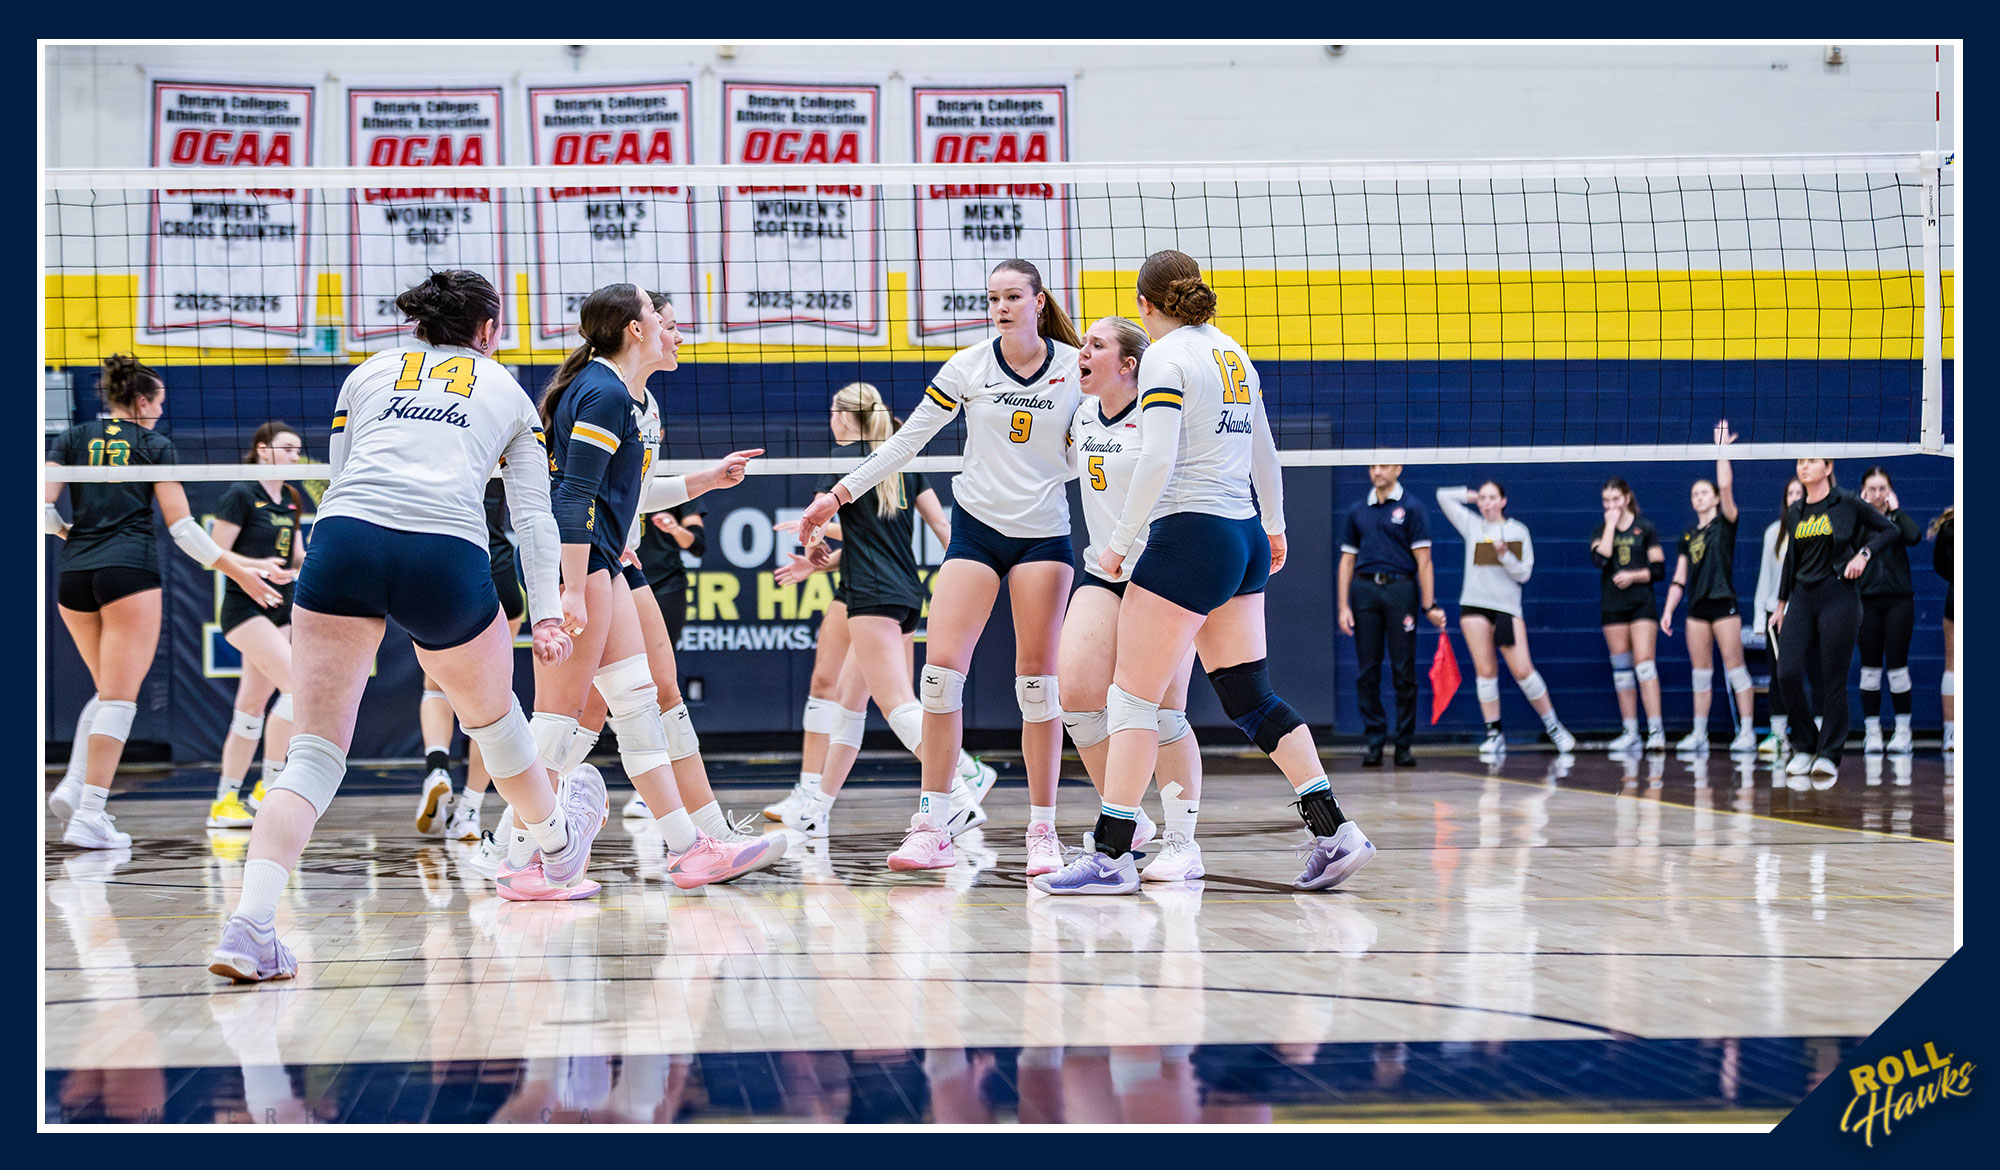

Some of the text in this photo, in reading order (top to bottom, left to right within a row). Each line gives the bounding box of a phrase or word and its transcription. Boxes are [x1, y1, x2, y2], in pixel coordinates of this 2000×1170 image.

[171, 129, 291, 166] OCAA
[369, 135, 483, 166] OCAA
[553, 129, 673, 165] OCAA
[742, 129, 859, 163] OCAA
[932, 133, 1048, 163] OCAA
[192, 203, 269, 220] WOMEN'S
[385, 207, 472, 224] WOMEN'S
[587, 203, 646, 221] MEN'S
[757, 201, 846, 219] WOMEN'S
[963, 204, 1023, 220] MEN'S
[163, 221, 215, 239] CROSS
[406, 228, 449, 245] GOLF
[593, 223, 639, 241] GOLF
[755, 221, 847, 239] SOFTBALL
[963, 225, 1023, 241] RUGBY
[174, 293, 281, 313] 2025-2026
[747, 291, 852, 310] 2025-2026
[394, 352, 477, 398] 14
[1212, 349, 1251, 404] 12
[993, 392, 1054, 410] Humber
[378, 396, 470, 429] Hawks
[1215, 410, 1252, 434] Hawks
[1009, 410, 1033, 443] 9
[1080, 436, 1123, 453] Humber
[1088, 456, 1107, 491] 5
